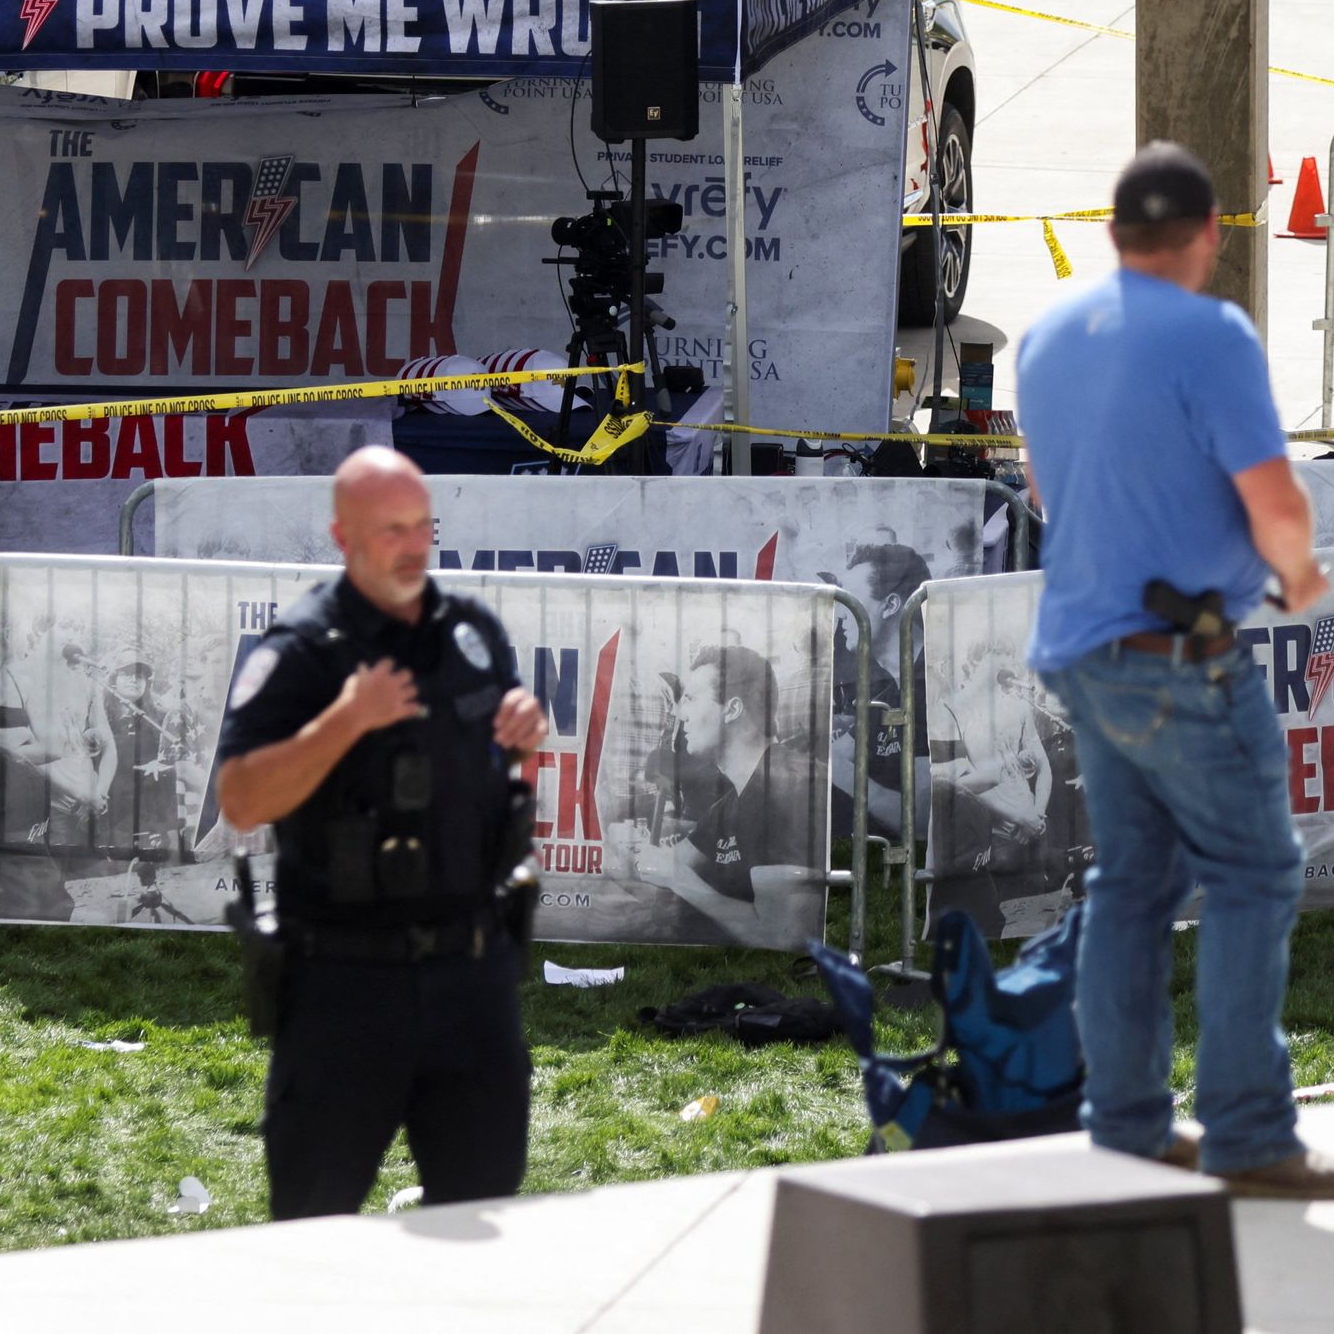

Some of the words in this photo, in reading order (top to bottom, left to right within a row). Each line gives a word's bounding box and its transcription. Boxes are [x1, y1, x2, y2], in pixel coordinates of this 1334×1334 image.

[752, 91, 783, 106] USA
[50, 130, 93, 156] THE
[597, 151, 649, 162] PRIVA
[650, 154, 705, 165] STUDENT
[744, 157, 783, 167] RELIEF
[644, 234, 781, 263] EFY.COM
[6, 155, 432, 385] AMERICAN
[252, 394, 281, 407] POLICE
[283, 393, 302, 404] LINE
[304, 392, 315, 403] DO
[317, 390, 333, 401] NOT
[336, 388, 363, 399] CROSS
[7, 413, 18, 424] DO
[21, 411, 38, 423] NOT
[40, 409, 67, 422] CROSS
[104, 404, 133, 417] POLICE
[135, 403, 153, 415] LINE
[155, 402, 167, 414] DO
[170, 401, 186, 413] NOT
[188, 399, 216, 411] CROSS
[543, 844, 603, 874] TOUR
